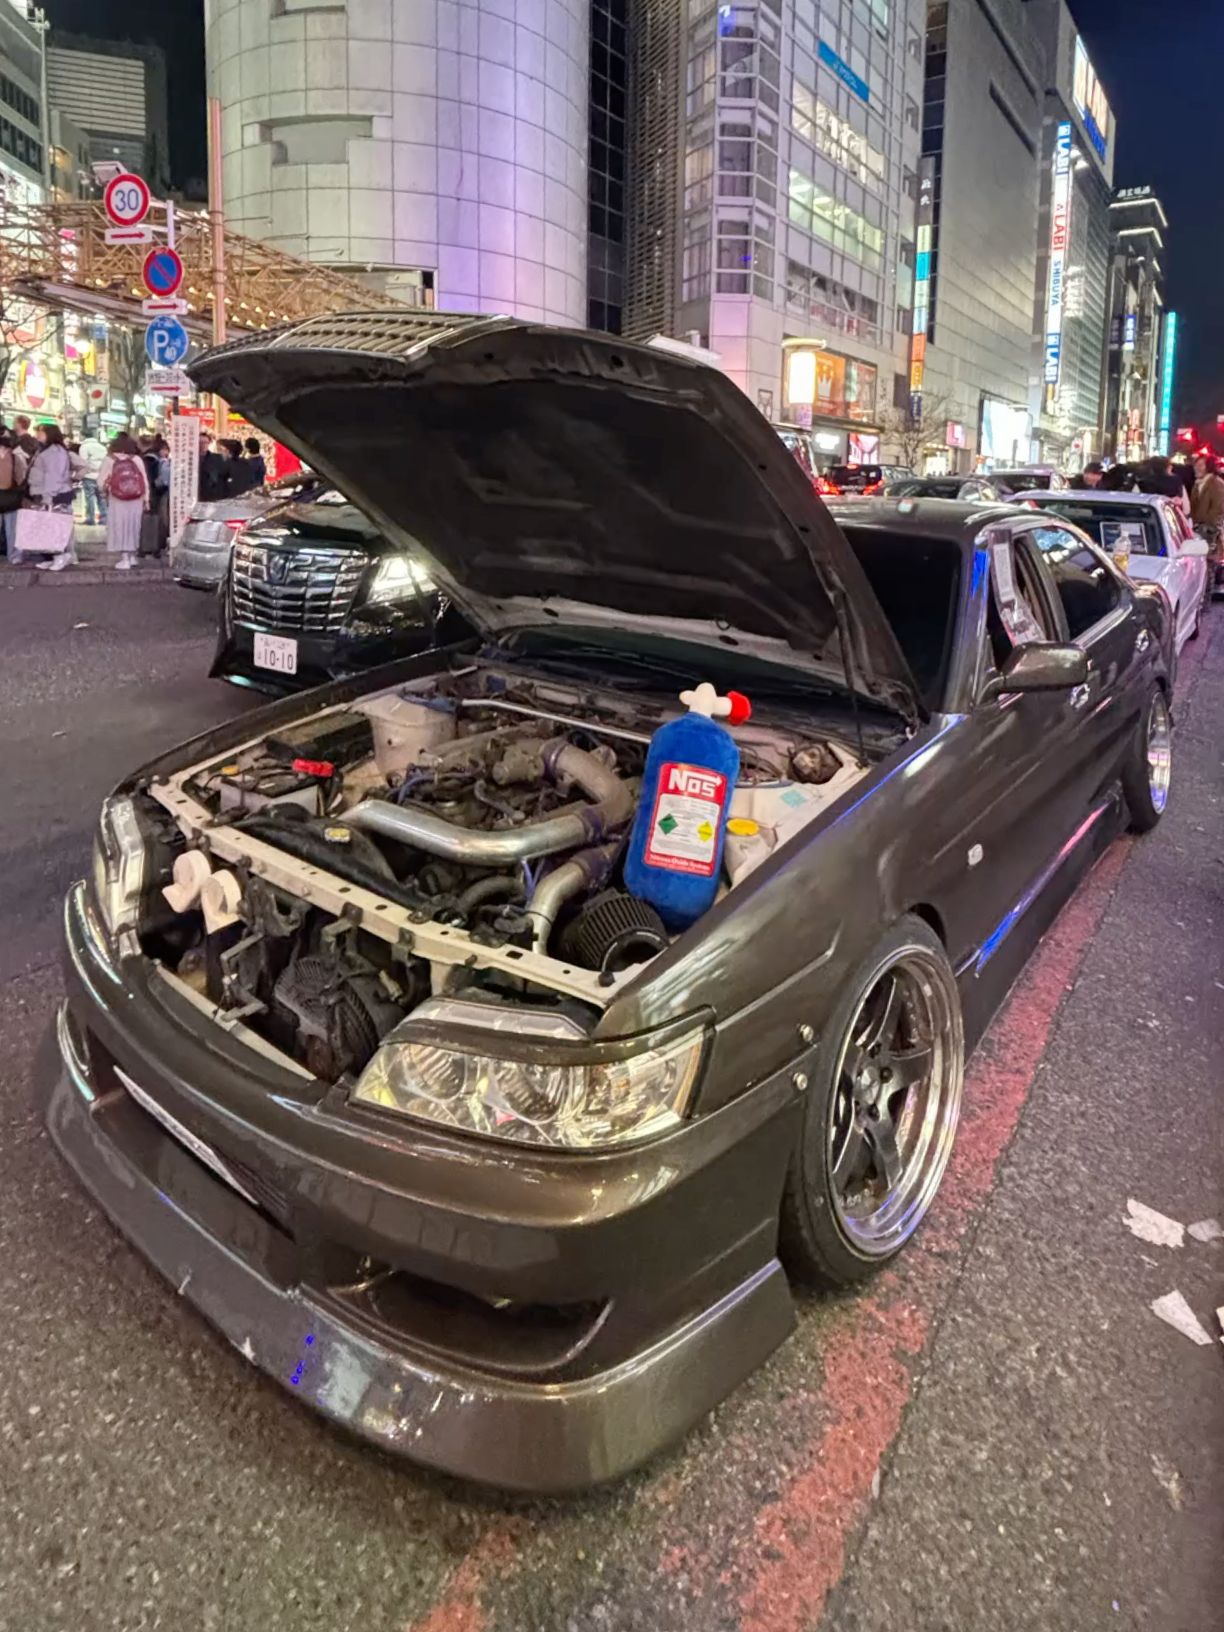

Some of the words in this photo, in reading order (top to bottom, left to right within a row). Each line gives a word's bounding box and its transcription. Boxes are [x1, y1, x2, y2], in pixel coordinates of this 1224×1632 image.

[114, 188, 139, 212] 30
[1053, 214, 1066, 251] LABI
[1051, 260, 1062, 306] SHIBUYA
[153, 329, 170, 361] P
[668, 767, 716, 798] NOS
